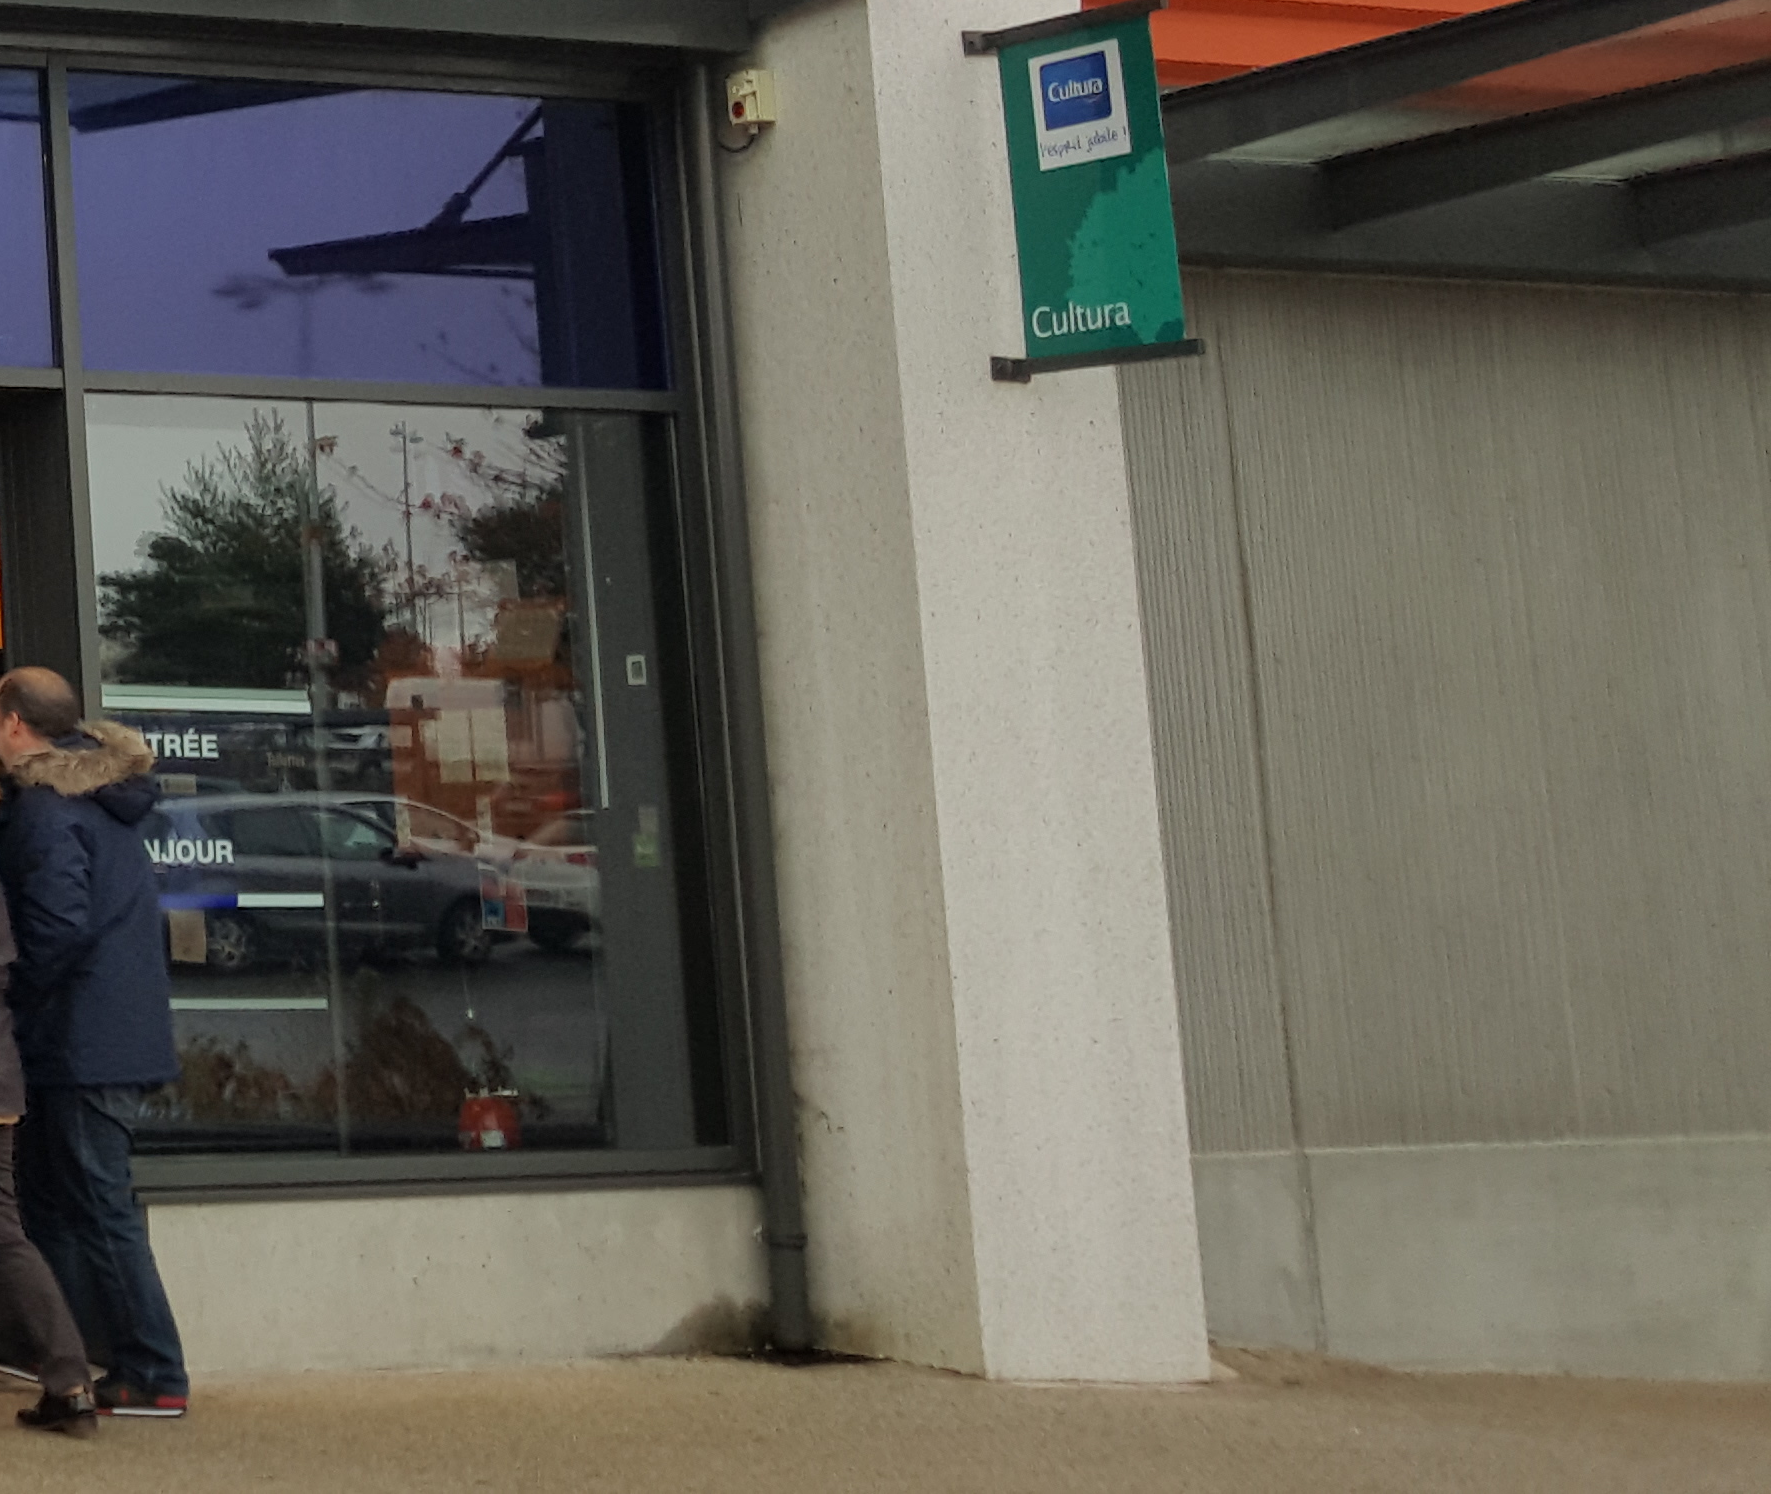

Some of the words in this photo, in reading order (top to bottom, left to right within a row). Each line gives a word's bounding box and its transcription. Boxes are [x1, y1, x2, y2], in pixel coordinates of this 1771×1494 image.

[1047, 78, 1103, 103] Cultura
[1031, 301, 1131, 339] Cultura
[145, 728, 219, 758] TRÉE
[143, 839, 234, 864] NJOUR
